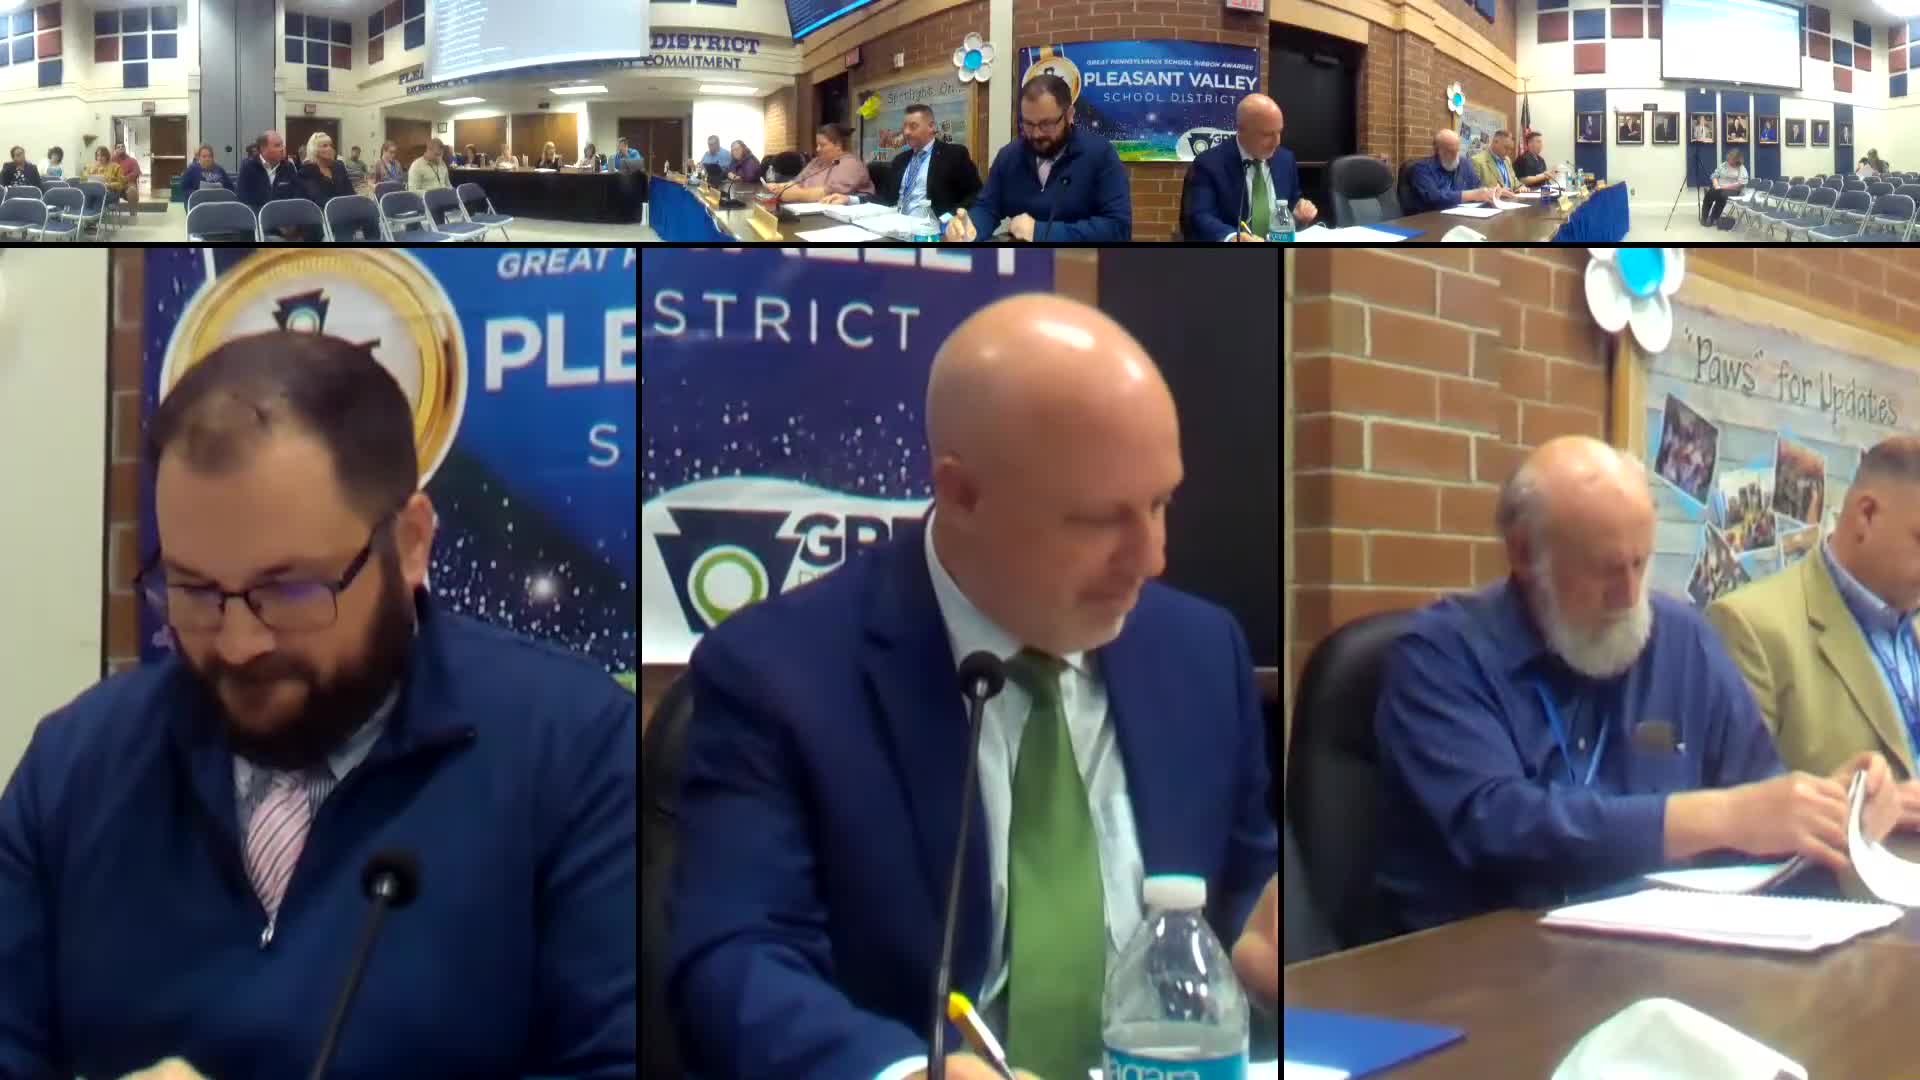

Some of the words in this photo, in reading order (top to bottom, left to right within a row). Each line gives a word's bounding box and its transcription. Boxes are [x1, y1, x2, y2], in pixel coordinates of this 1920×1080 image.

[651, 33, 760, 54] DISTRICT
[644, 54, 741, 69] COMMITMENT
[1084, 71, 1184, 87] PLEASANT
[1189, 73, 1257, 91] VALLEY
[1103, 92, 1162, 102] SCHOOL
[1171, 93, 1236, 105] DISTRICT
[497, 248, 615, 279] GREAT
[653, 290, 921, 351] STRICT
[1777, 359, 1812, 406] for
[1820, 371, 1898, 425] Updates
[588, 423, 620, 467] S
